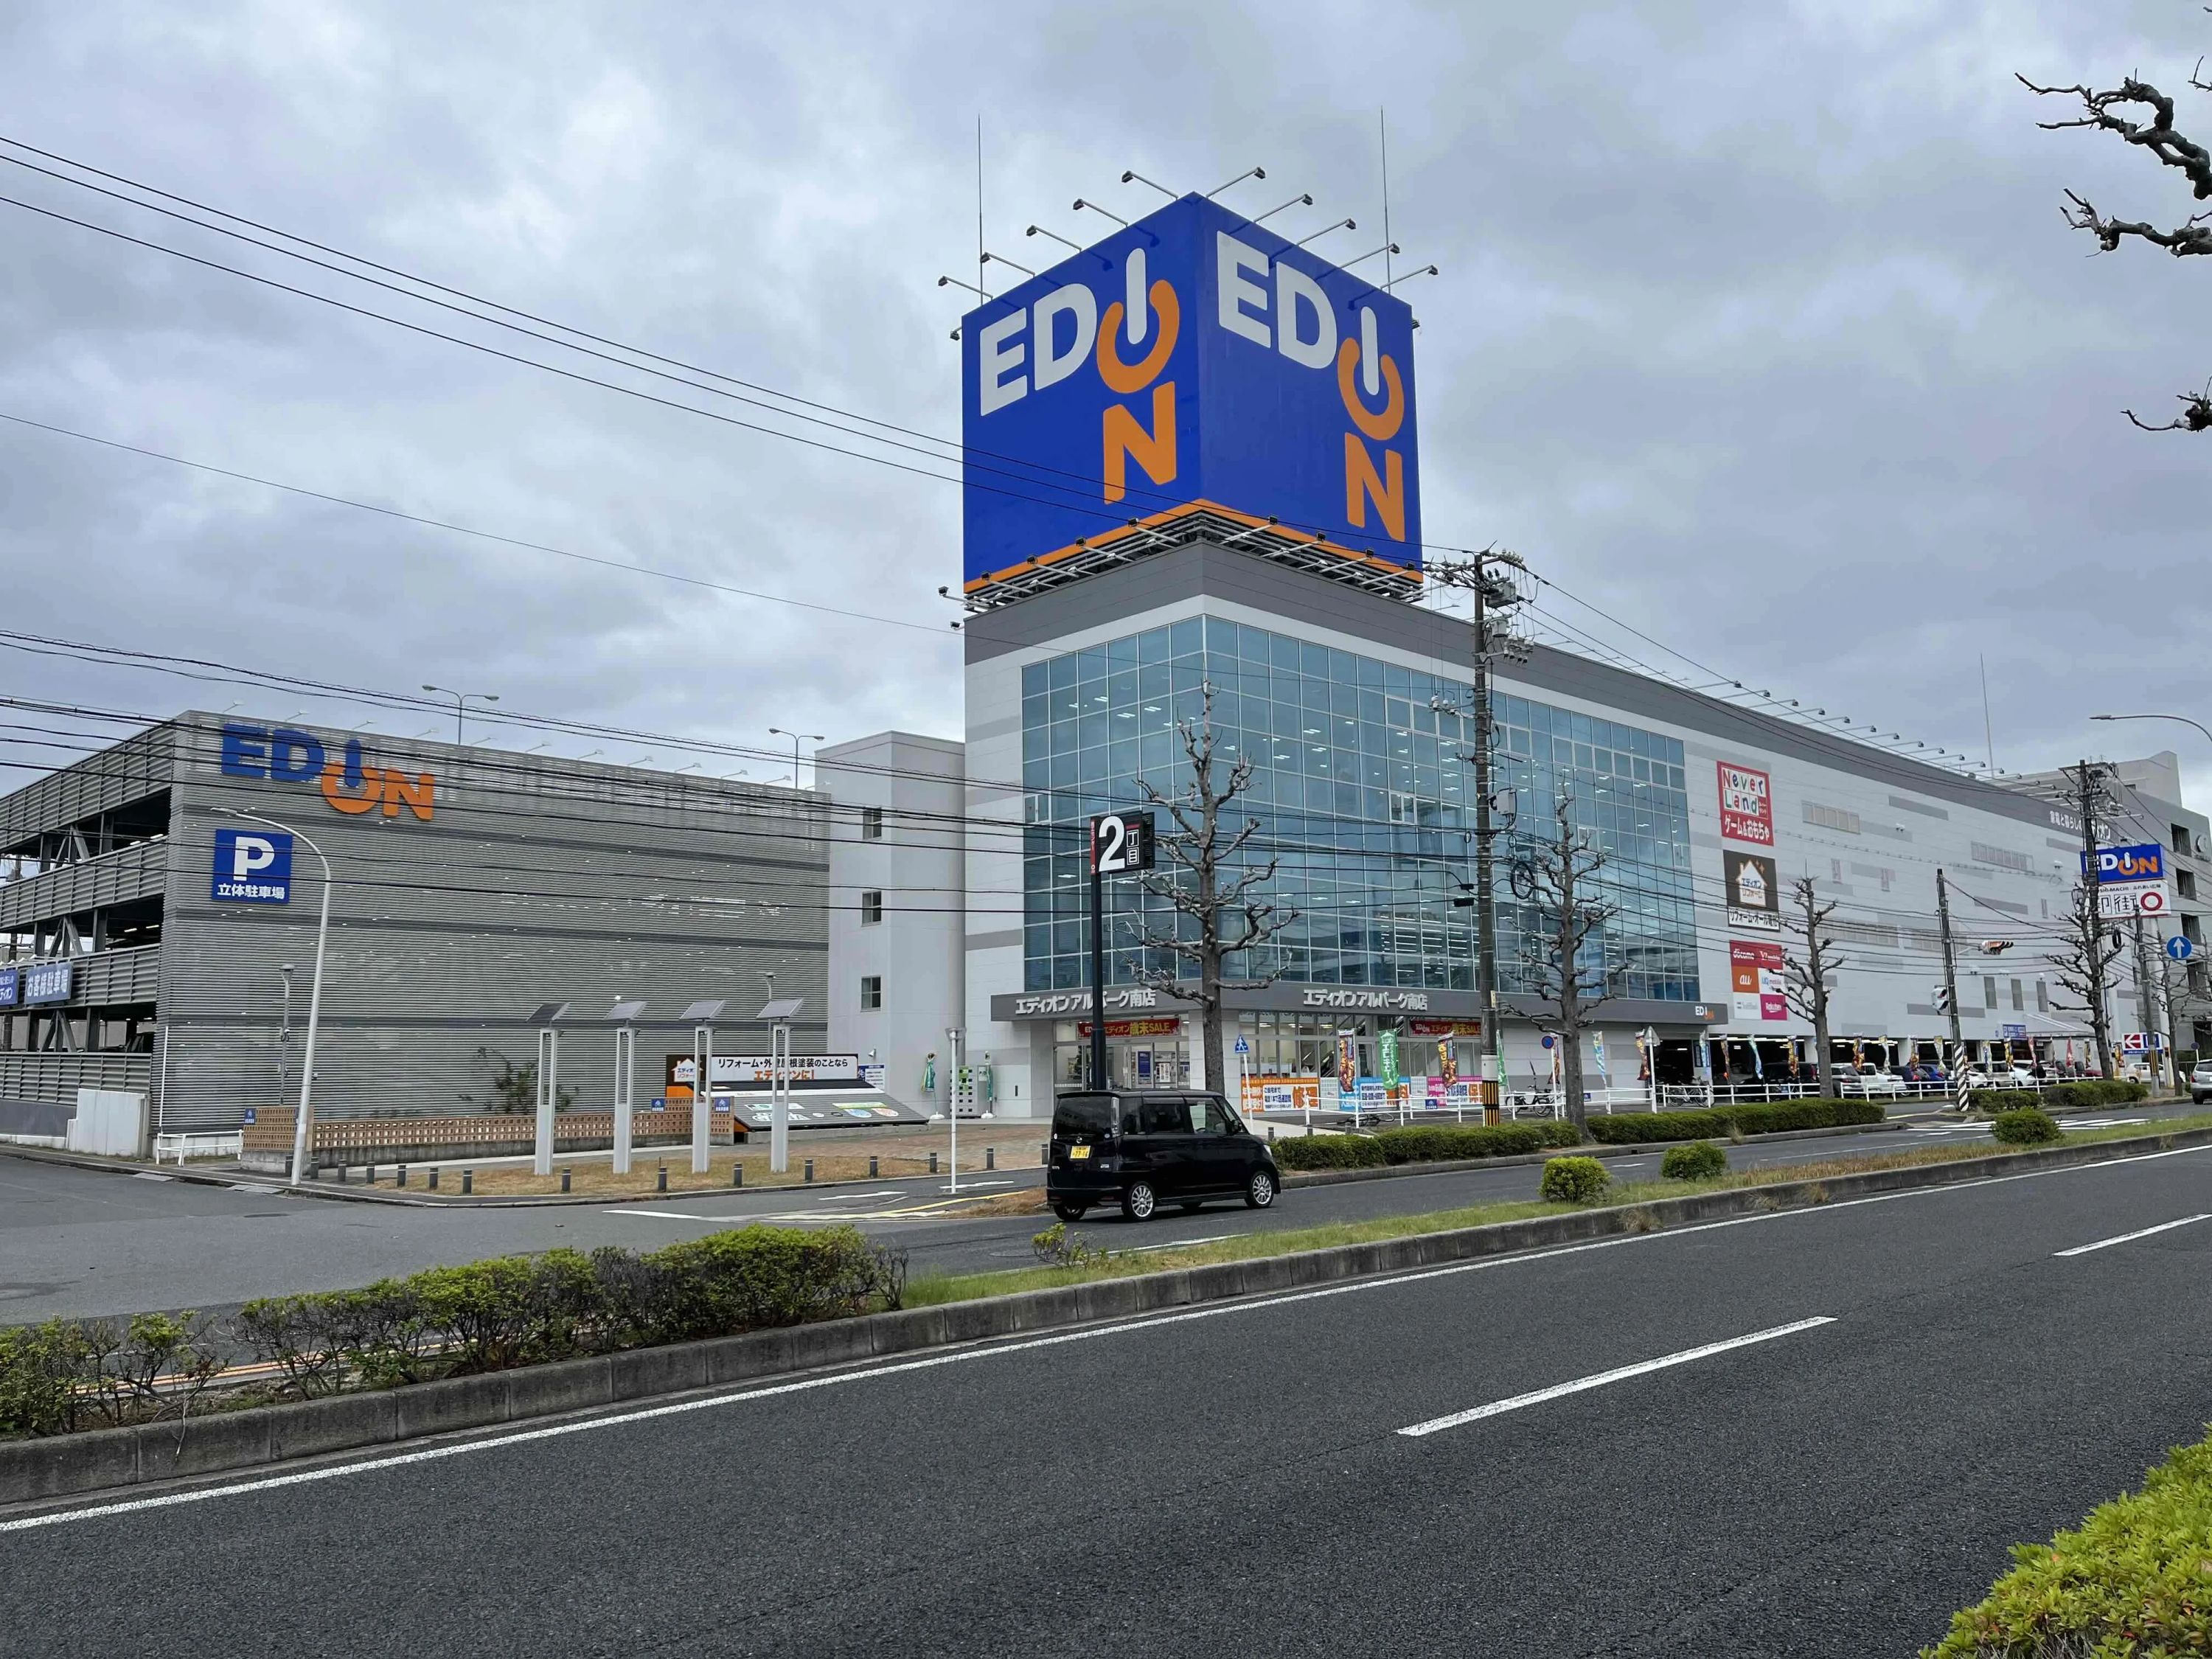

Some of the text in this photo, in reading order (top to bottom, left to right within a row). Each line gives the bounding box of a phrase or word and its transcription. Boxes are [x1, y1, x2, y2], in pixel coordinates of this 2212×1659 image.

[222, 723, 435, 821] EDION
[1722, 770, 1764, 794] Never
[1725, 790, 1757, 815] Land
[233, 836, 275, 881] P
[217, 883, 285, 900] 立体駐車場
[1739, 974, 1752, 985] au
